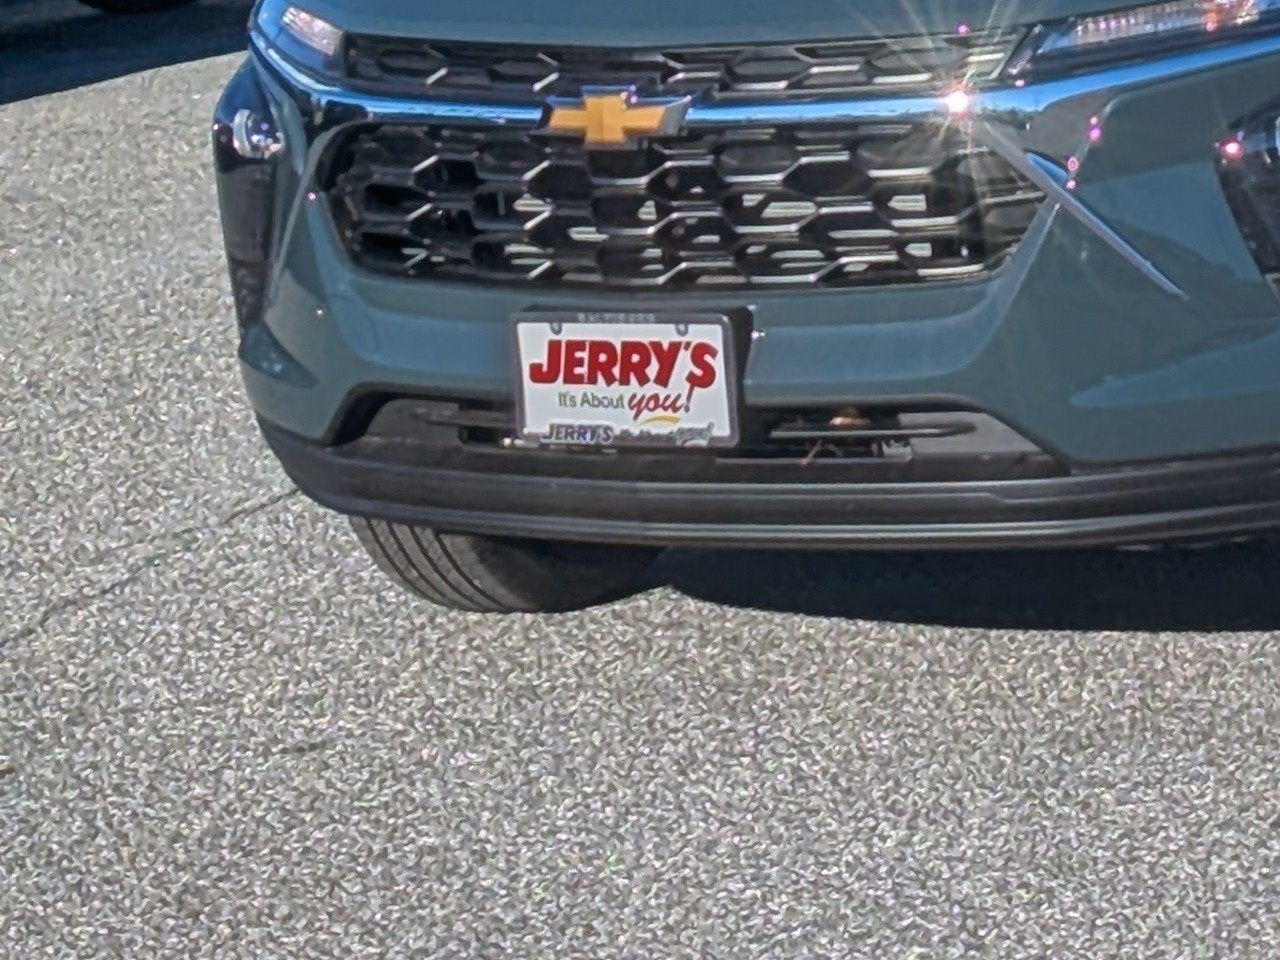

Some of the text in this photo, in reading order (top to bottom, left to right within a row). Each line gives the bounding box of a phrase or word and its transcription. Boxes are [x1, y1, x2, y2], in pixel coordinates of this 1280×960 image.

[529, 340, 718, 389] JERRY'S
[558, 386, 695, 421] It's About you!
